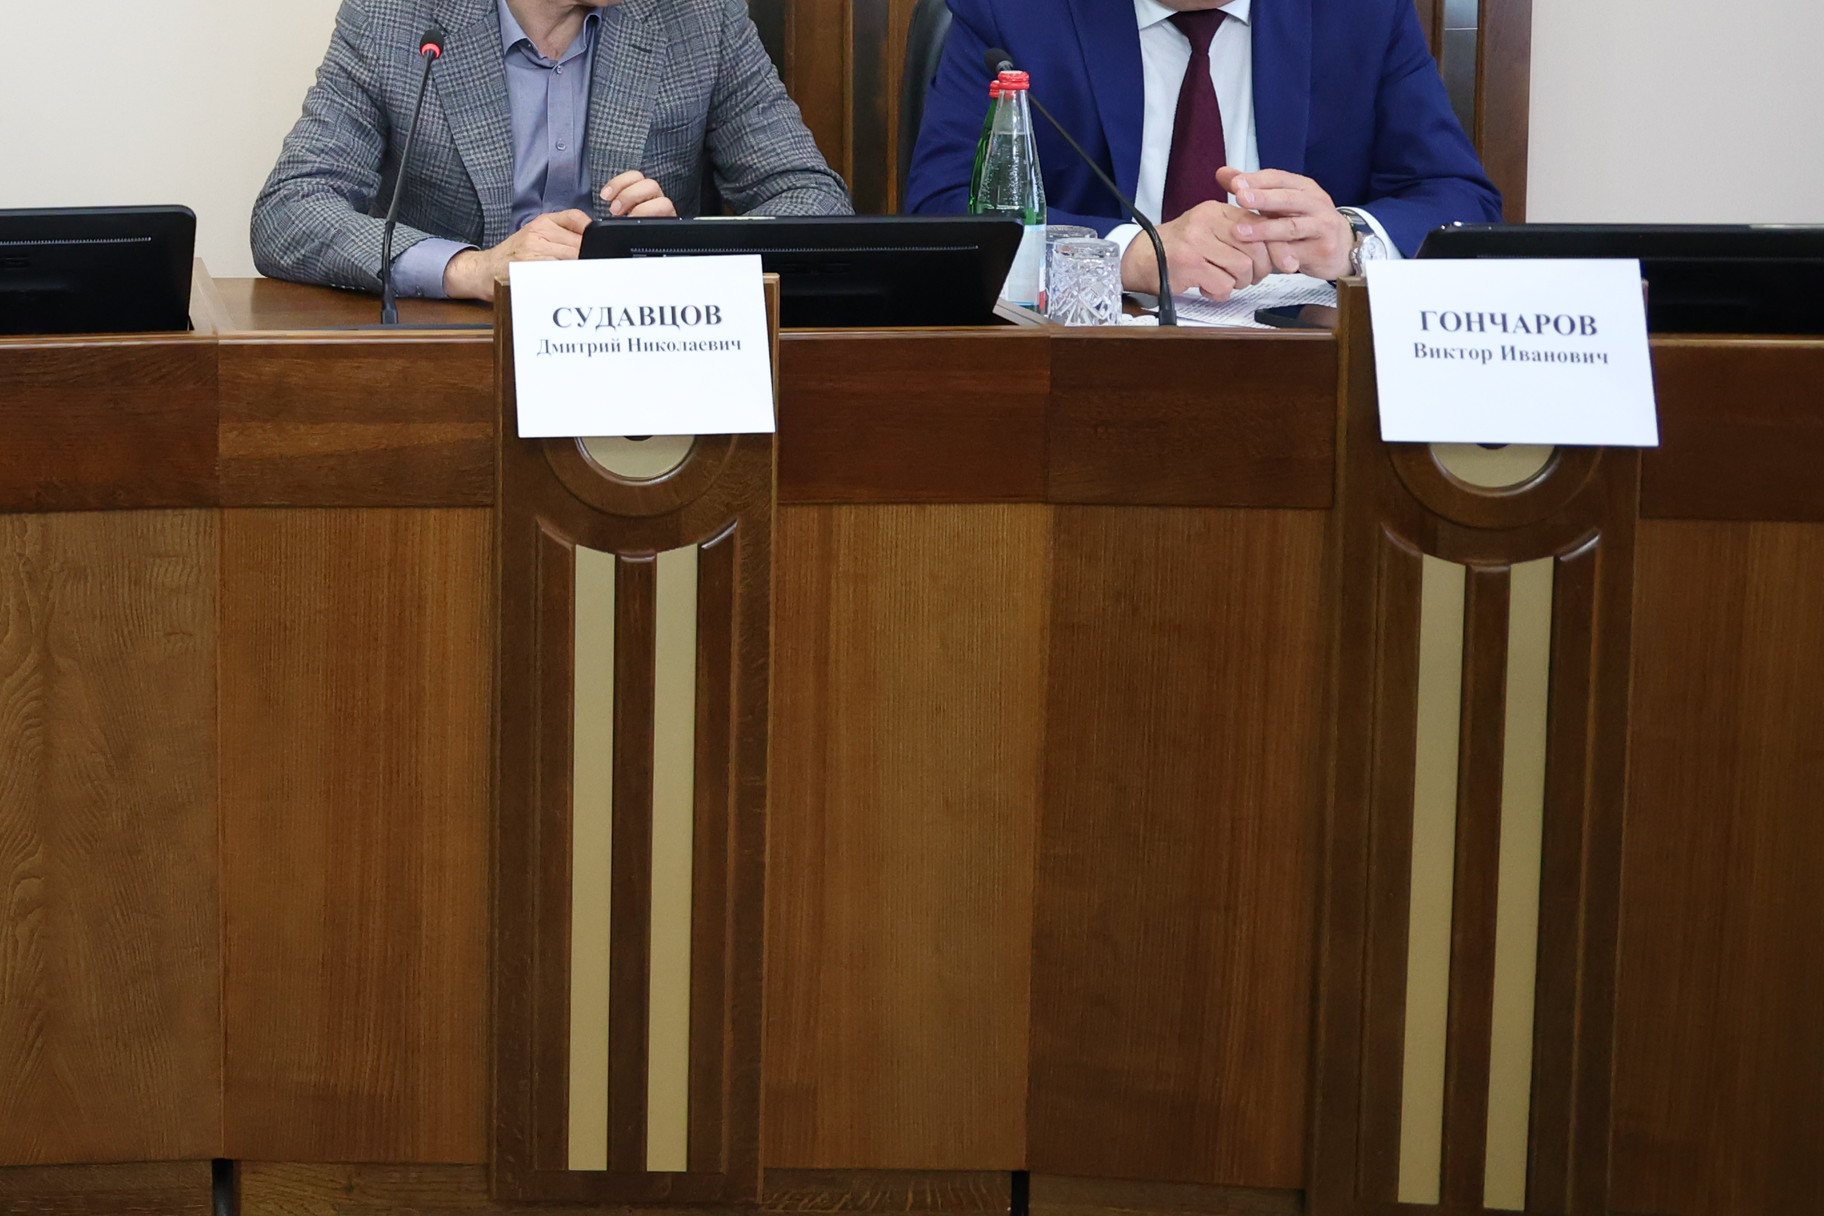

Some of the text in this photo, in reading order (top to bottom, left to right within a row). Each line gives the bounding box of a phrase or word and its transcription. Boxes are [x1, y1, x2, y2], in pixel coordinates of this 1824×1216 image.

[552, 304, 723, 332] СУДАВЦОВ
[1419, 310, 1598, 336] ГОНЧАРОВ
[537, 337, 742, 358] Дмитрий Николаевич
[1414, 342, 1609, 365] Виктор Иванович
